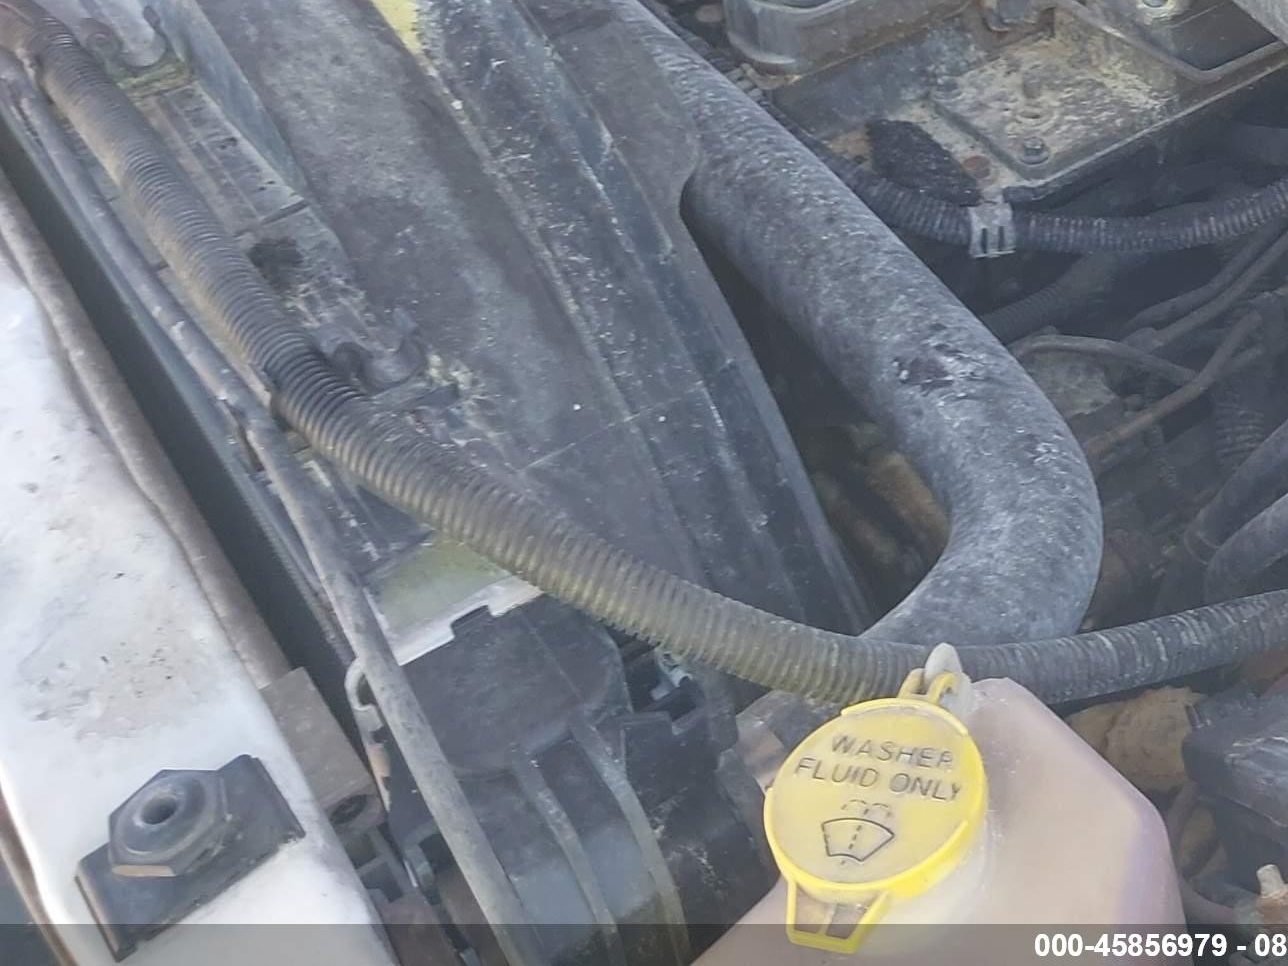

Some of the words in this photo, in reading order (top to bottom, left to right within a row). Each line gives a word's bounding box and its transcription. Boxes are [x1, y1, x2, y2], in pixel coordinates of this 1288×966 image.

[831, 734, 954, 771] WASHER
[793, 756, 880, 788] FLUID
[888, 772, 962, 802] ONLY
